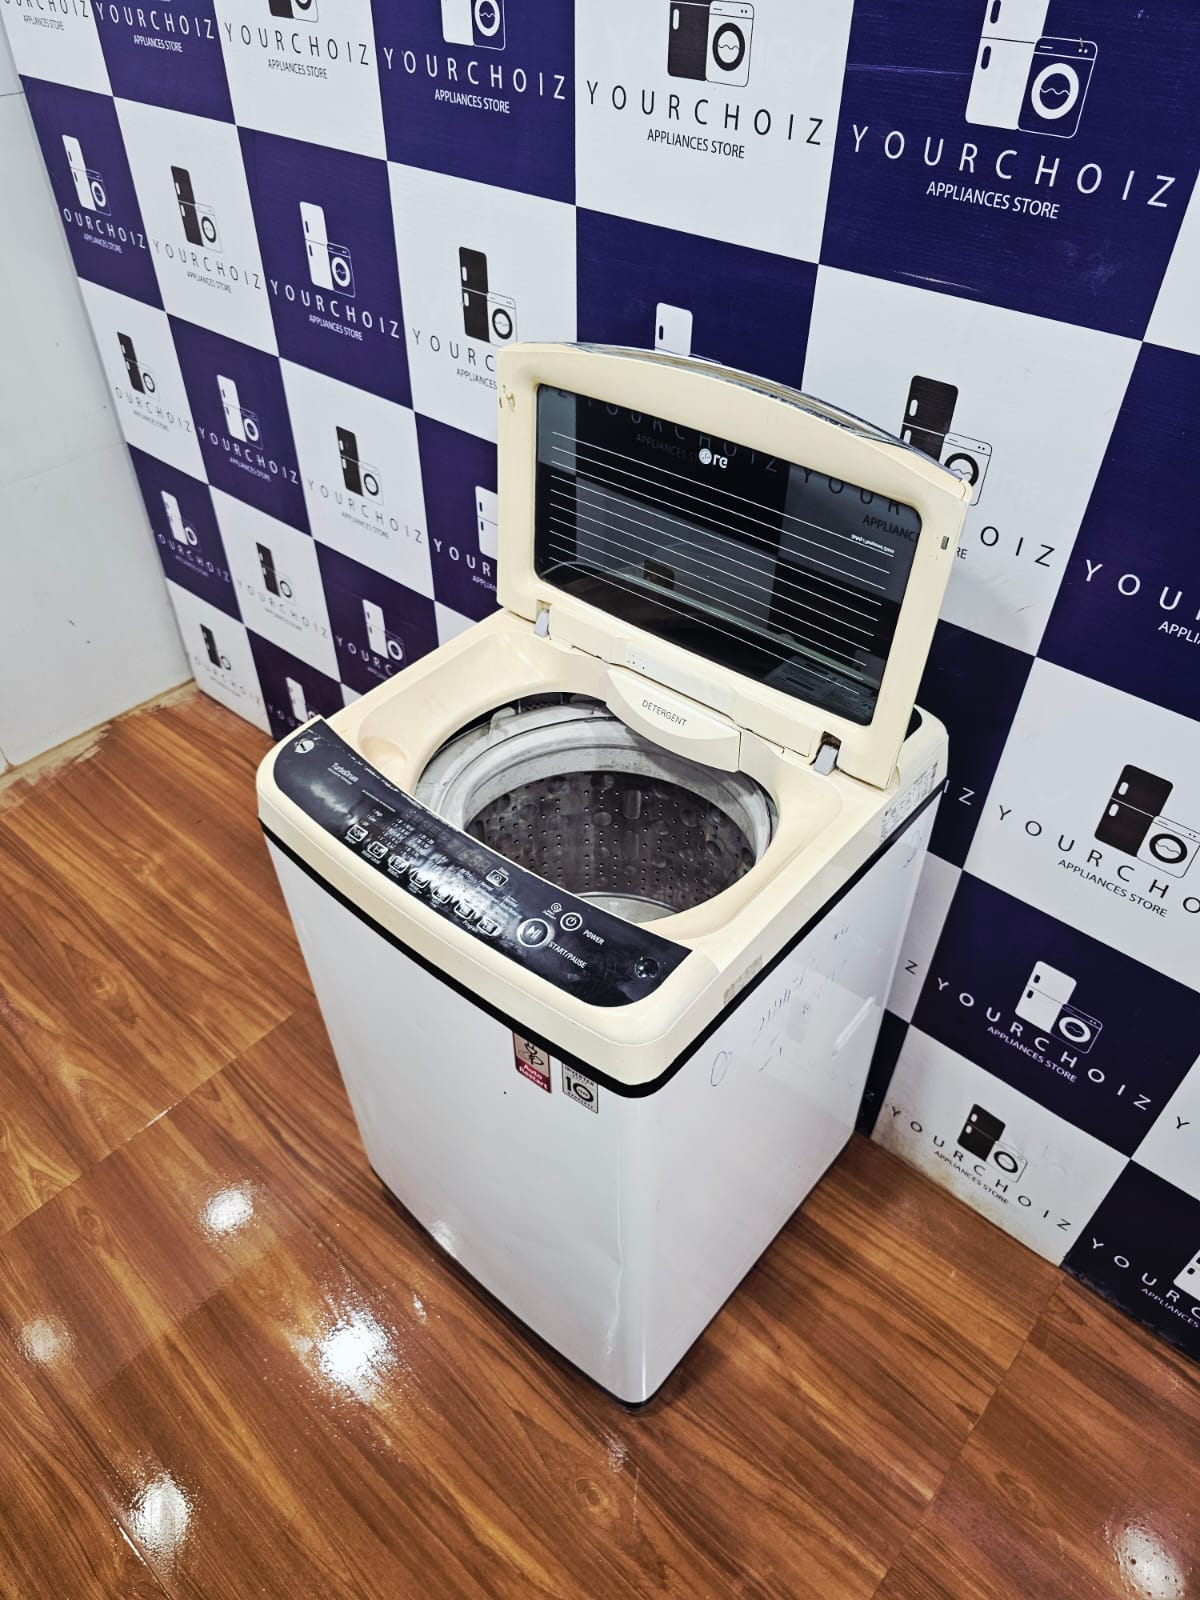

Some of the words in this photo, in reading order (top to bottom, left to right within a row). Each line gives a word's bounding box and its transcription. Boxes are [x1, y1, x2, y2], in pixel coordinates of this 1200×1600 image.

[96, 3, 215, 39] YOURCHOIZ
[133, 35, 165, 50] APPLIANCES
[165, 42, 183, 52] STORE
[225, 22, 369, 66] YOURCHOIZ
[268, 59, 306, 76] APPLIANCES
[305, 65, 327, 79] STORE
[383, 47, 566, 100] YOURCHOIZ
[435, 89, 482, 108] APPLIANCES
[483, 98, 510, 113] STORE
[587, 80, 823, 145] YOURCHOIZ
[647, 129, 709, 151] APPLIANCES
[711, 140, 745, 158] STORE
[852, 124, 1175, 208] YOURCHOIZ
[926, 181, 1010, 210] APPLIANCES
[1012, 197, 1060, 219] STORE
[152, 239, 261, 289] YOURCHOIZ
[270, 279, 400, 339] YOURCHOIZ
[308, 314, 344, 334] APPLIANCES
[344, 326, 363, 341] STORE
[198, 426, 299, 484] YOURCHOIZ
[307, 479, 423, 544] YOURCHOIZ
[641, 698, 688, 728] DETERGENT
[1057, 858, 1128, 898] APPLIANCES
[1129, 893, 1169, 918] STORE
[548, 941, 588, 969] START/PAUSE
[582, 928, 605, 946] POWER
[936, 977, 1151, 1111] YOURCHOIZ
[987, 1025, 1044, 1064] APPLIANCES
[1041, 1058, 1078, 1083] STORE
[891, 1105, 1072, 1232] YOURCHOIZ
[934, 1150, 984, 1188] APPLIANCES
[1140, 1287, 1200, 1329] APPLIANCES
